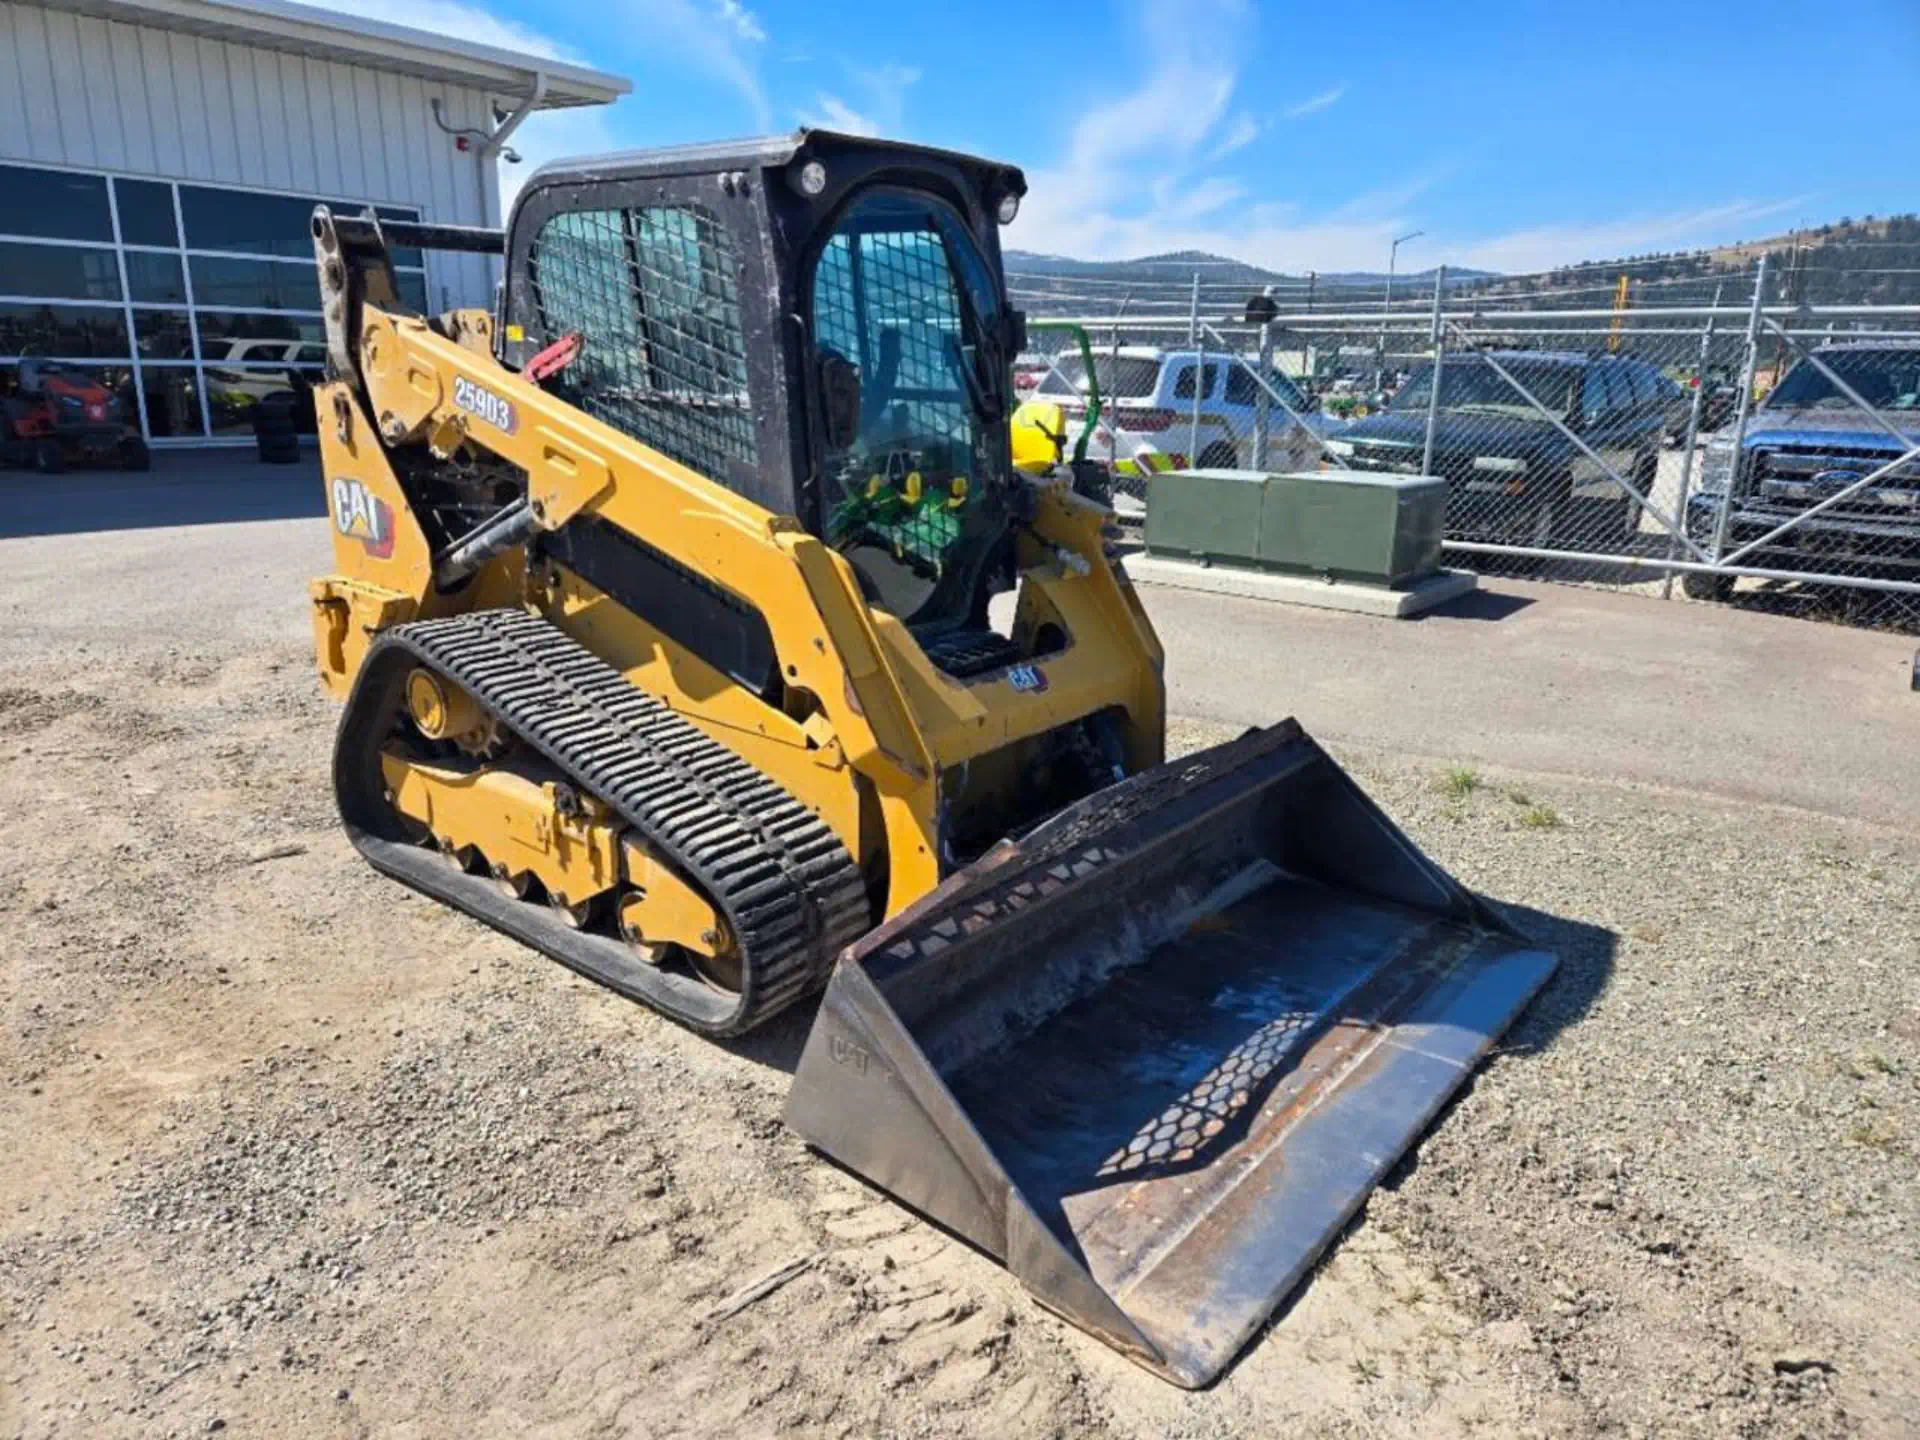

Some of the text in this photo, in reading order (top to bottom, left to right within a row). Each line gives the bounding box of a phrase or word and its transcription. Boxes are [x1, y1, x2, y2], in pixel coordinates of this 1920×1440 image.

[454, 376, 509, 430] 259D3
[333, 478, 382, 541] CAT
[1008, 665, 1040, 690] CAT
